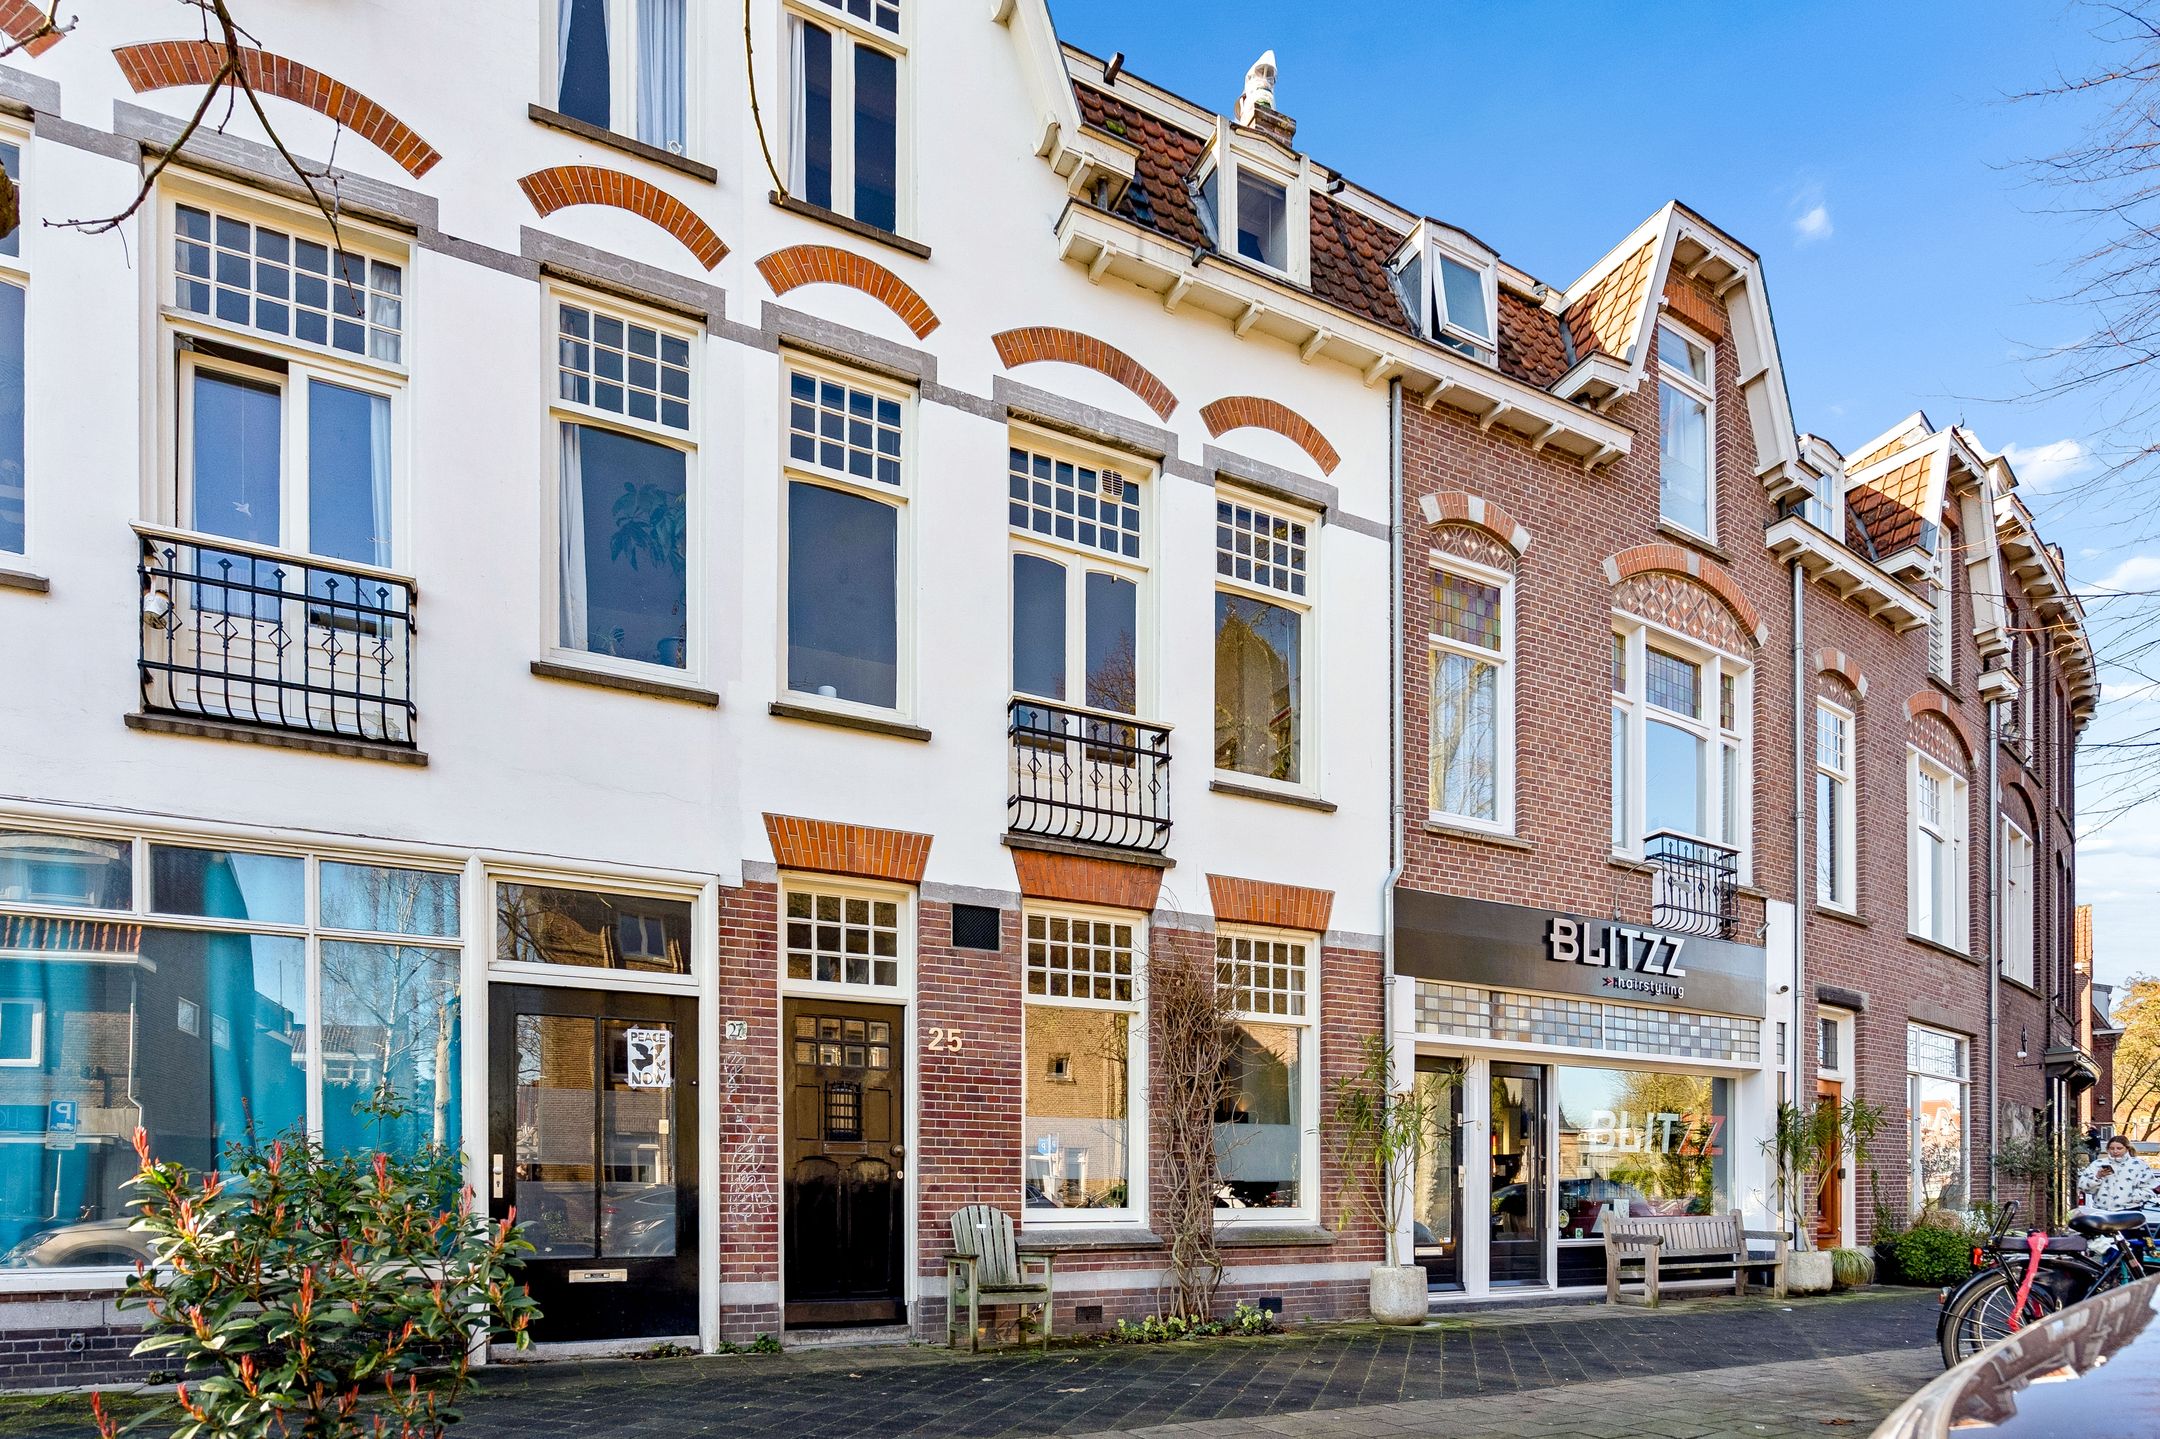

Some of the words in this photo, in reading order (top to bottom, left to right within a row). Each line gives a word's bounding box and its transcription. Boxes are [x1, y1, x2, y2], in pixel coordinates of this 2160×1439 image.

[1550, 917, 1686, 977] BLITZZ
[1618, 976, 1685, 999] hairstyling
[630, 1031, 666, 1043] PEACE
[728, 1022, 743, 1037] 27
[928, 1027, 963, 1052] 25
[631, 1071, 667, 1085] NOW
[1588, 1109, 1727, 1156] BLITZZ
